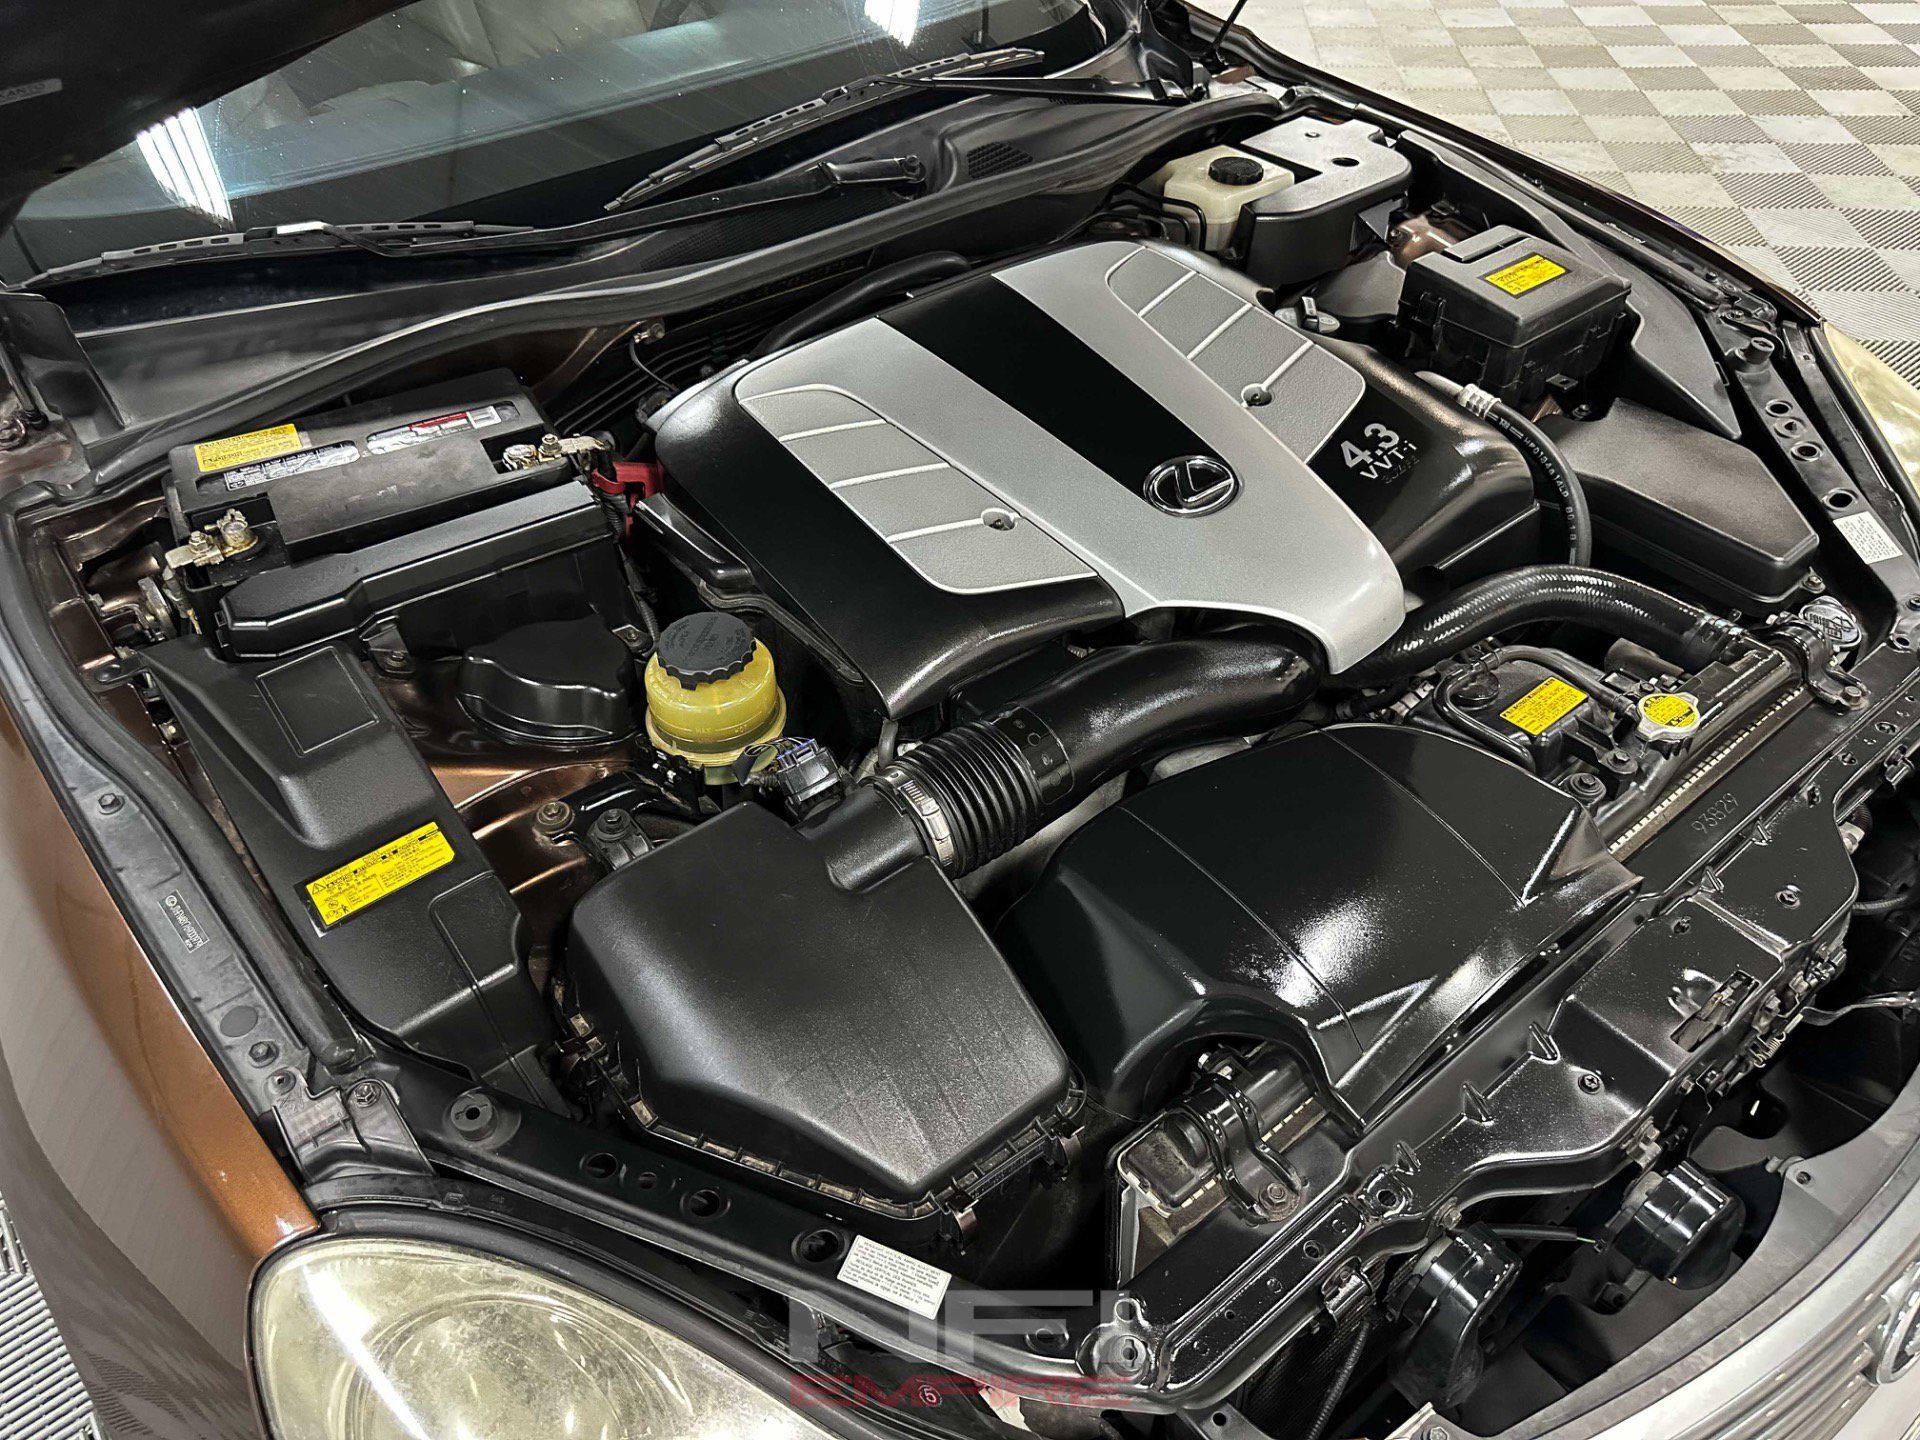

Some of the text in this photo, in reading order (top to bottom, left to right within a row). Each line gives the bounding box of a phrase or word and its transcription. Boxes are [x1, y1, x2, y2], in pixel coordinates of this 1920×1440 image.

[1341, 423, 1399, 468] 4.3
[1360, 440, 1417, 479] VVT-i
[1691, 792, 1739, 834] 93829
